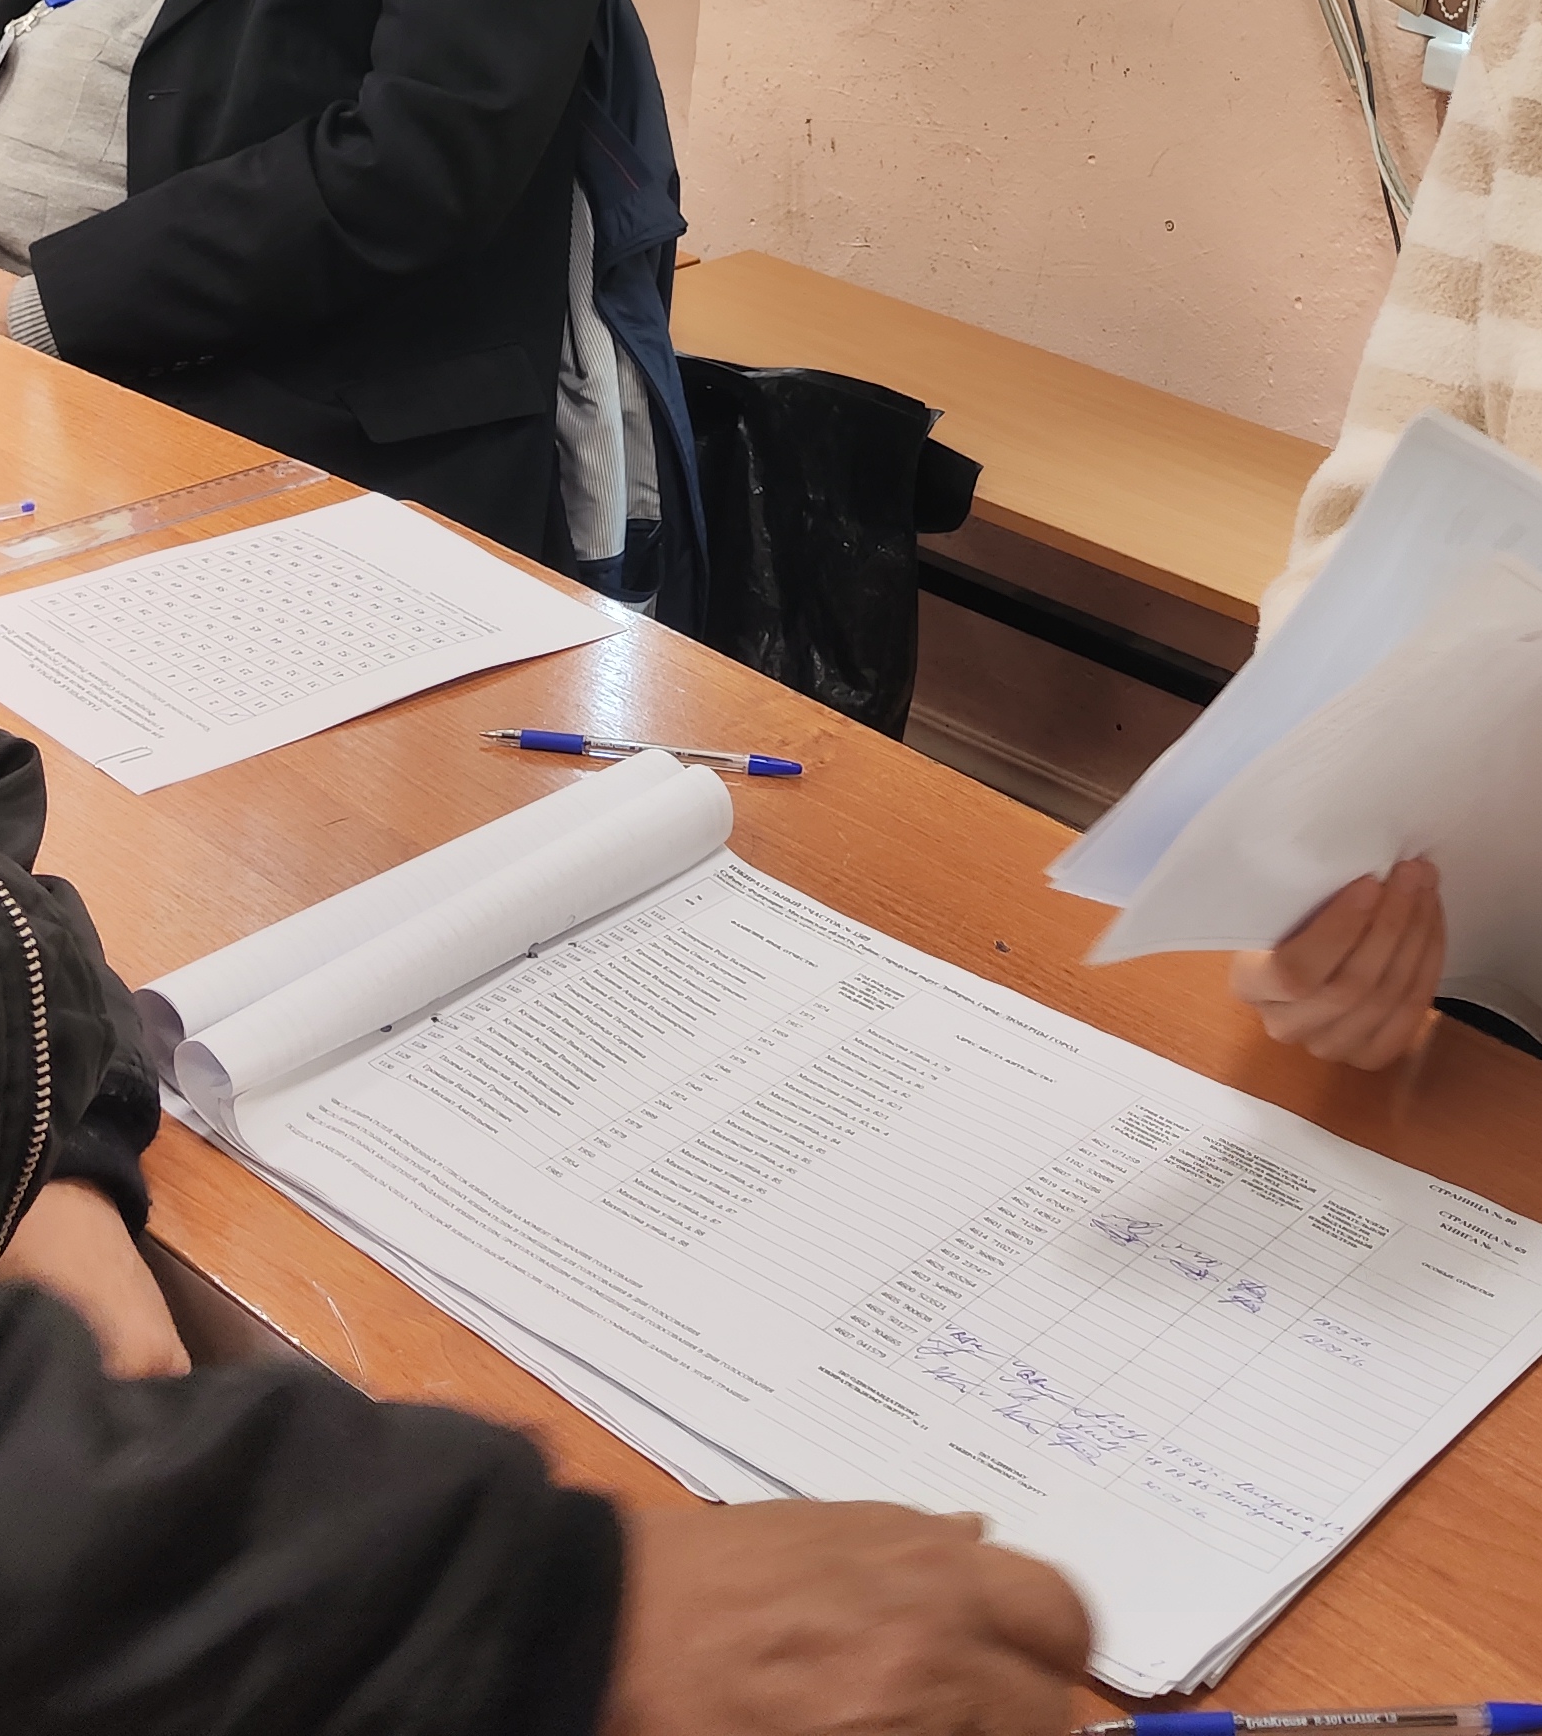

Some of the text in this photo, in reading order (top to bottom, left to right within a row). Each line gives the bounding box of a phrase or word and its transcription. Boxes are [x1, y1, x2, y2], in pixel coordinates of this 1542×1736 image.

[1428, 1184, 1489, 1214] СТРАНИЦА
[1439, 1210, 1499, 1242] СТРАНИЦА
[1439, 1223, 1478, 1245] КНИГА
